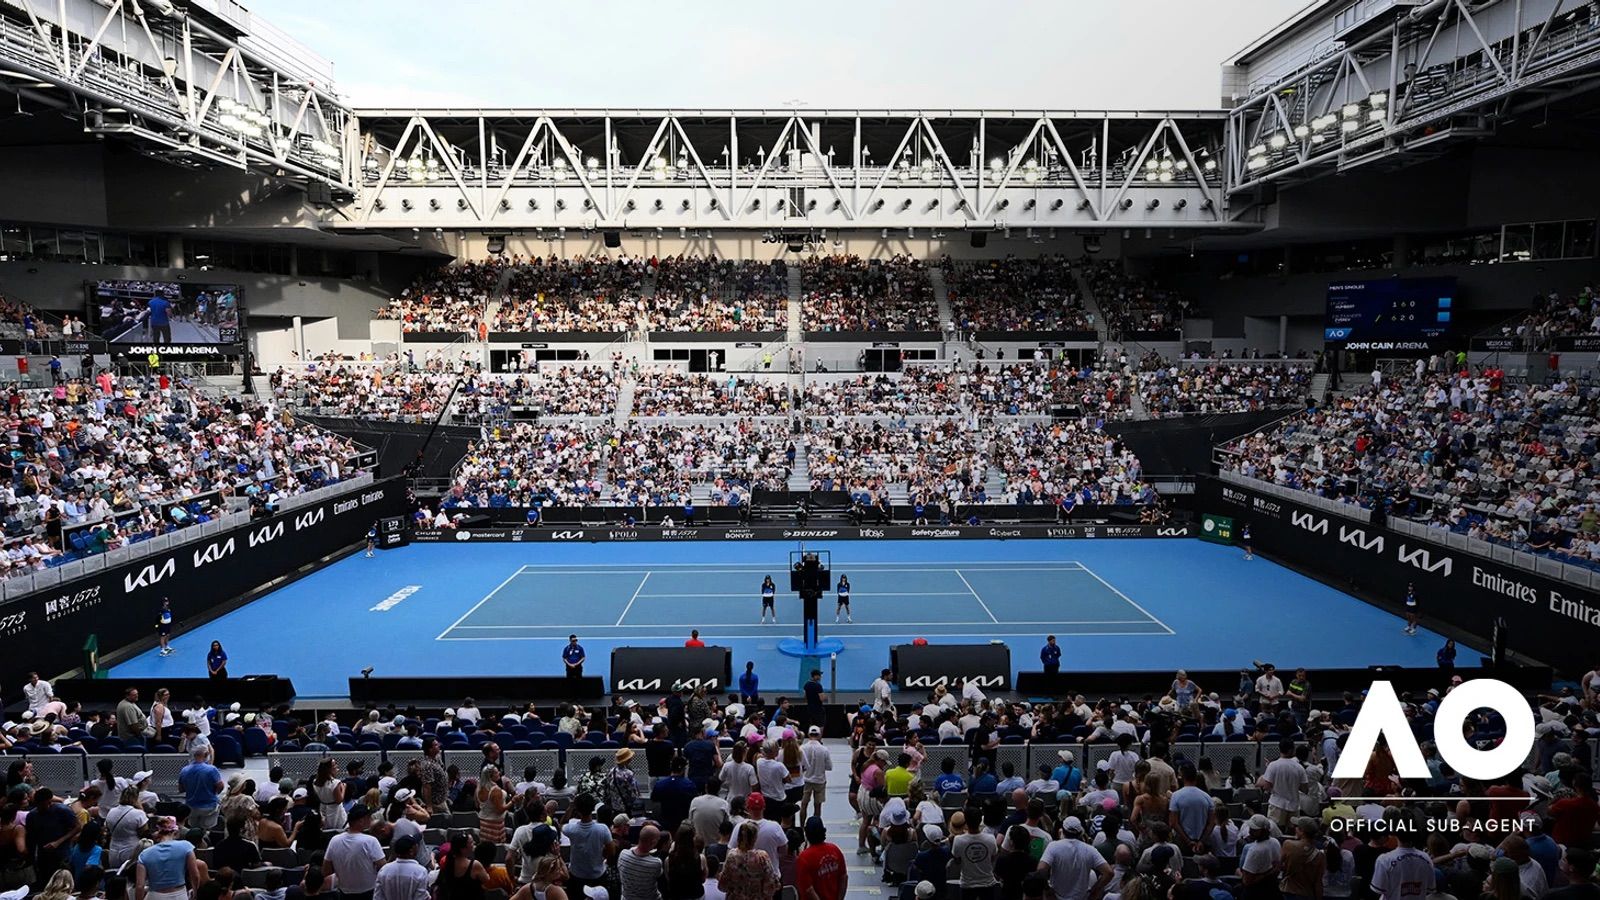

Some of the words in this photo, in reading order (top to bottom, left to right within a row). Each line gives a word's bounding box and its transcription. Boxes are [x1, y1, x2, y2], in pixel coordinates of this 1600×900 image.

[158, 346, 183, 354] CAIN
[185, 346, 219, 354] ARENA
[1345, 342, 1369, 350] JOHN
[361, 489, 384, 505] Emirates
[333, 498, 358, 515] Emirates
[859, 529, 885, 538] Infosys
[911, 529, 961, 537] SafetyCulture
[1473, 566, 1537, 604] Emirates
